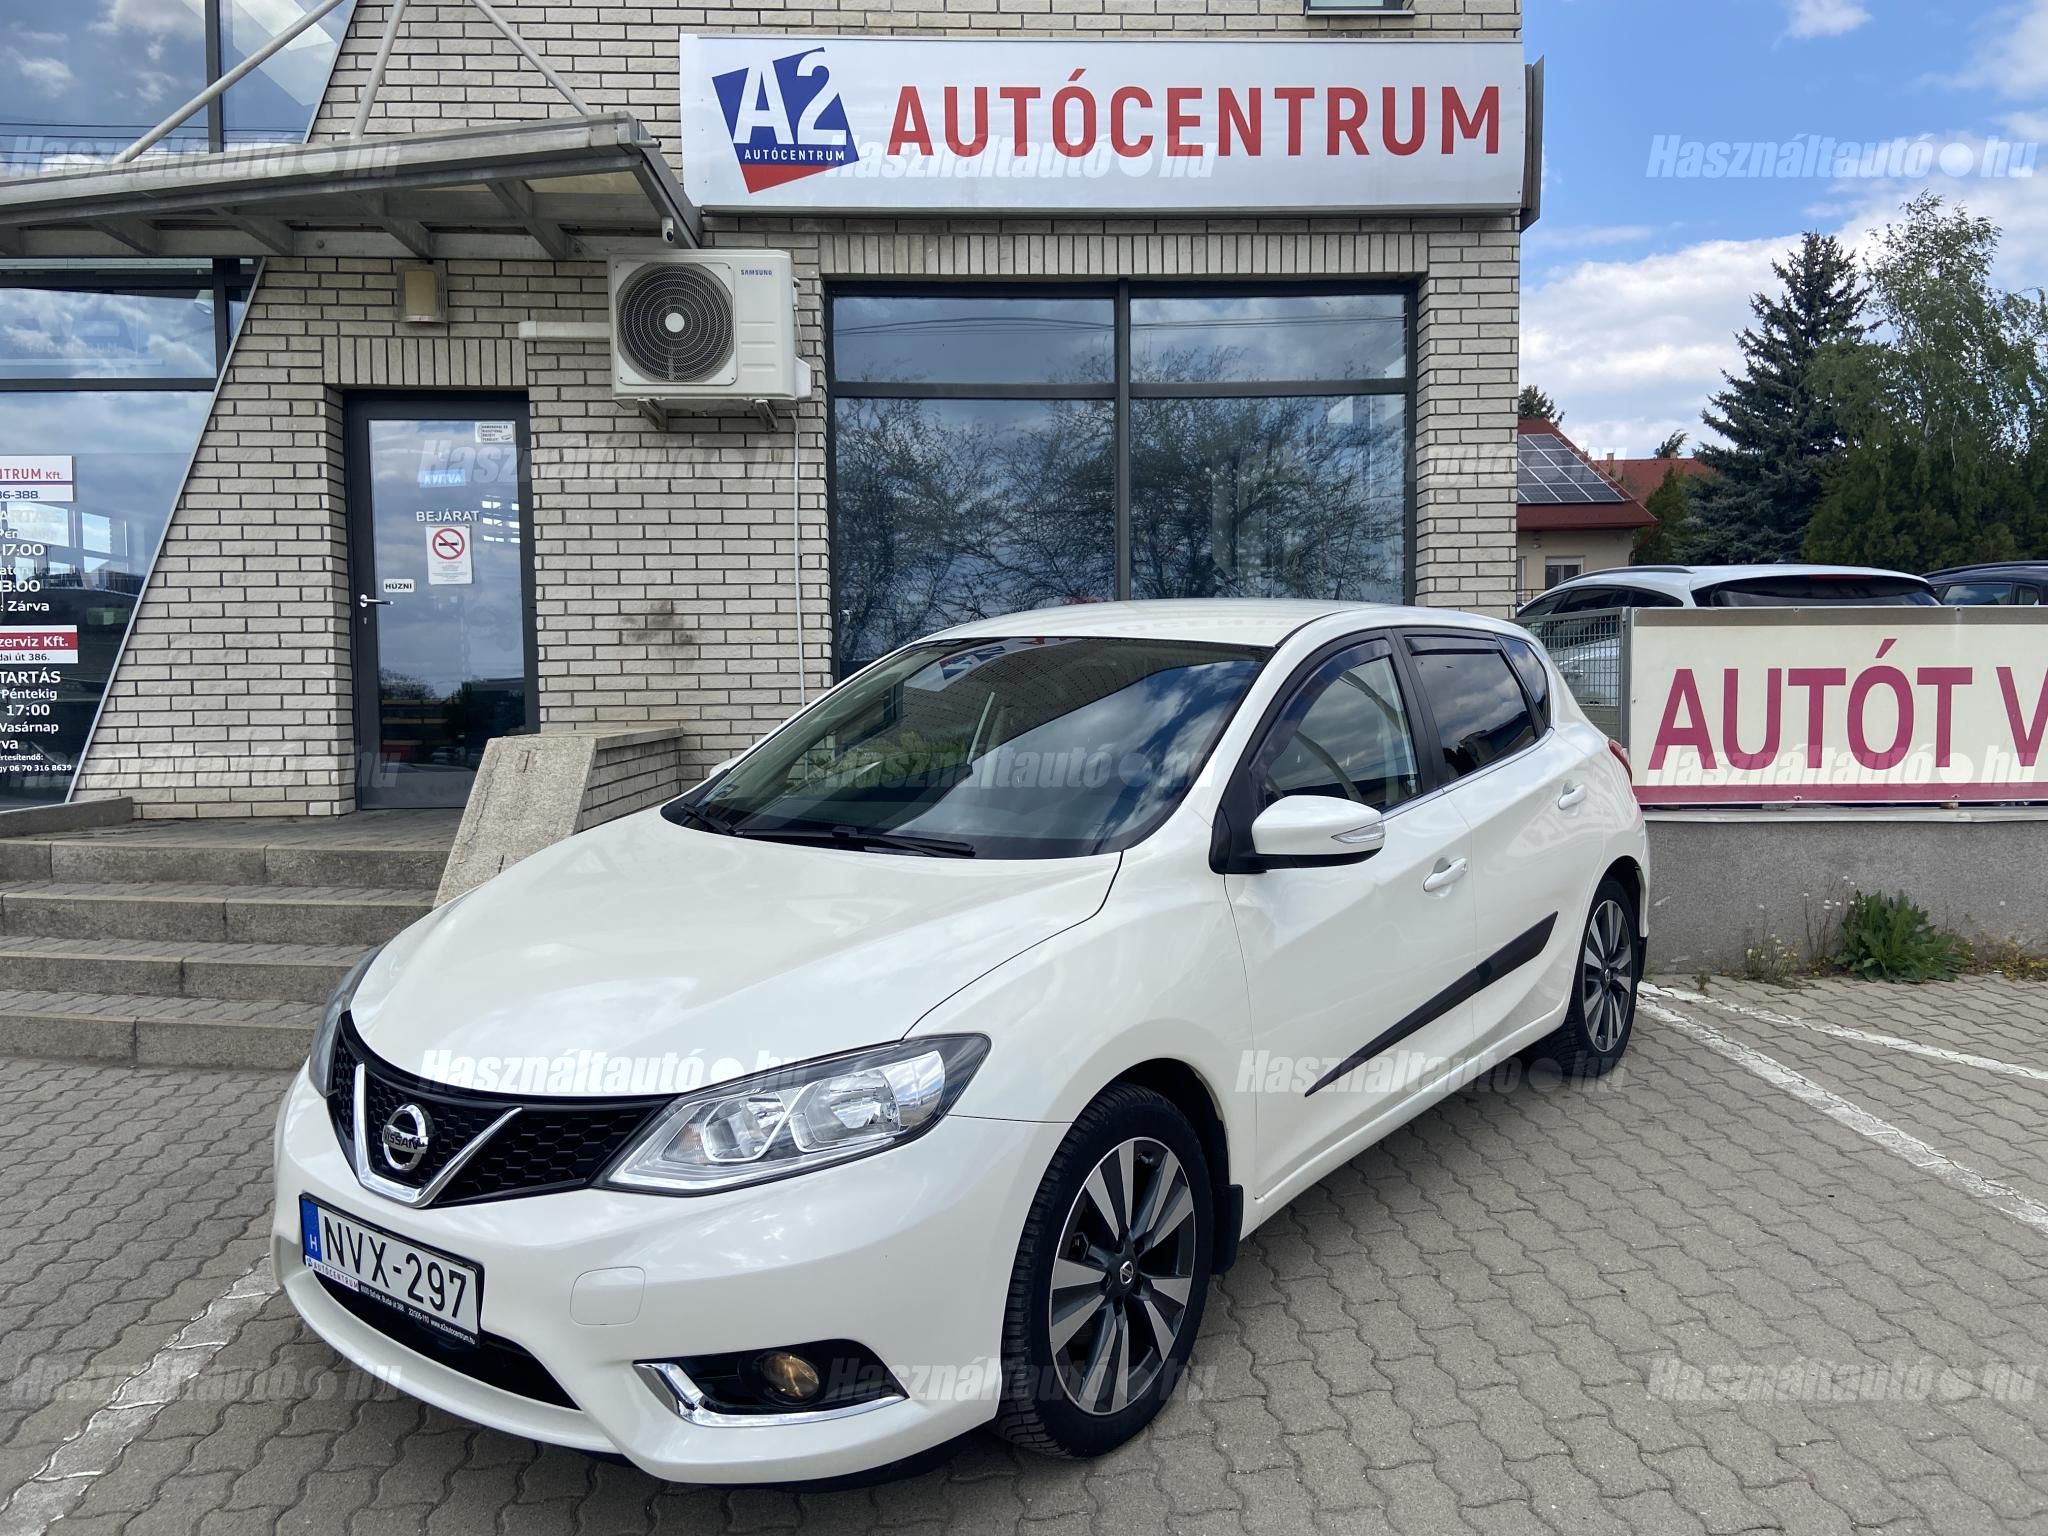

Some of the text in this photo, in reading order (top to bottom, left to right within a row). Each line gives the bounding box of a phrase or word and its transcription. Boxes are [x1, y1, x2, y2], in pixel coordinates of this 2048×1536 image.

[733, 50, 847, 145] A2
[887, 68, 1500, 157] AUTÓCENTRUM
[744, 148, 845, 161] AUTÓCENTRUM
[416, 509, 479, 522] BEJÁRAT
[2, 544, 45, 556] 17:00
[385, 581, 412, 590] HÚZNI
[7, 600, 50, 612] Zárva
[43, 636, 69, 647] Kft.
[28, 653, 50, 661] 386.
[1, 688, 58, 701] Péntekig
[6, 704, 51, 716] 17:00
[1647, 638, 1973, 771] AUTÓT
[0, 721, 59, 734] Vasárnap
[9, 764, 20, 772] 06
[21, 764, 33, 772] 70
[34, 764, 50, 772] 316
[51, 764, 72, 772] 8639
[309, 1234, 318, 1252] H
[324, 1215, 467, 1319] NVX-297
